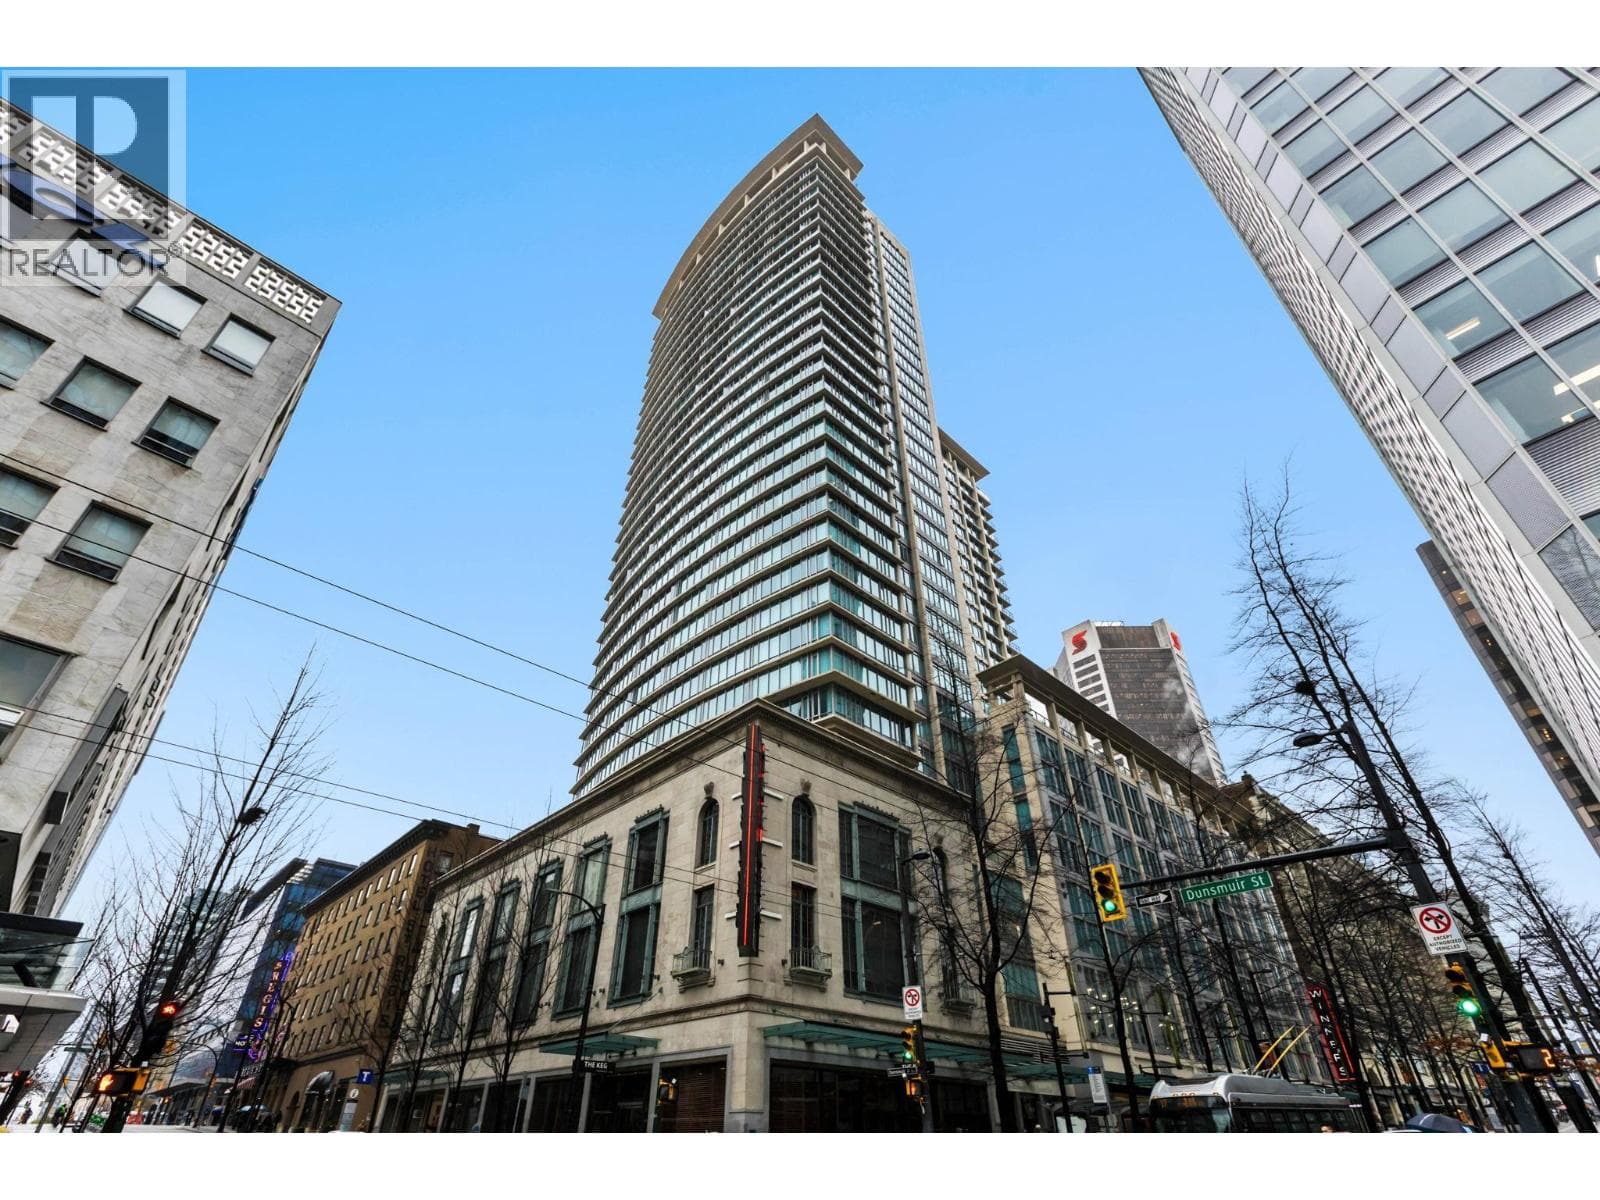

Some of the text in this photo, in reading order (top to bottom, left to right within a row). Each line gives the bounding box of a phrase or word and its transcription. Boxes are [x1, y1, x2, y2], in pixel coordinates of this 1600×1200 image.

[1186, 875, 1266, 900] Dunsmuir St
[1429, 938, 1462, 947] AUTHORIZED
[1540, 1049, 1556, 1068] 2
[584, 1061, 595, 1069] THE
[362, 1071, 371, 1082] T
